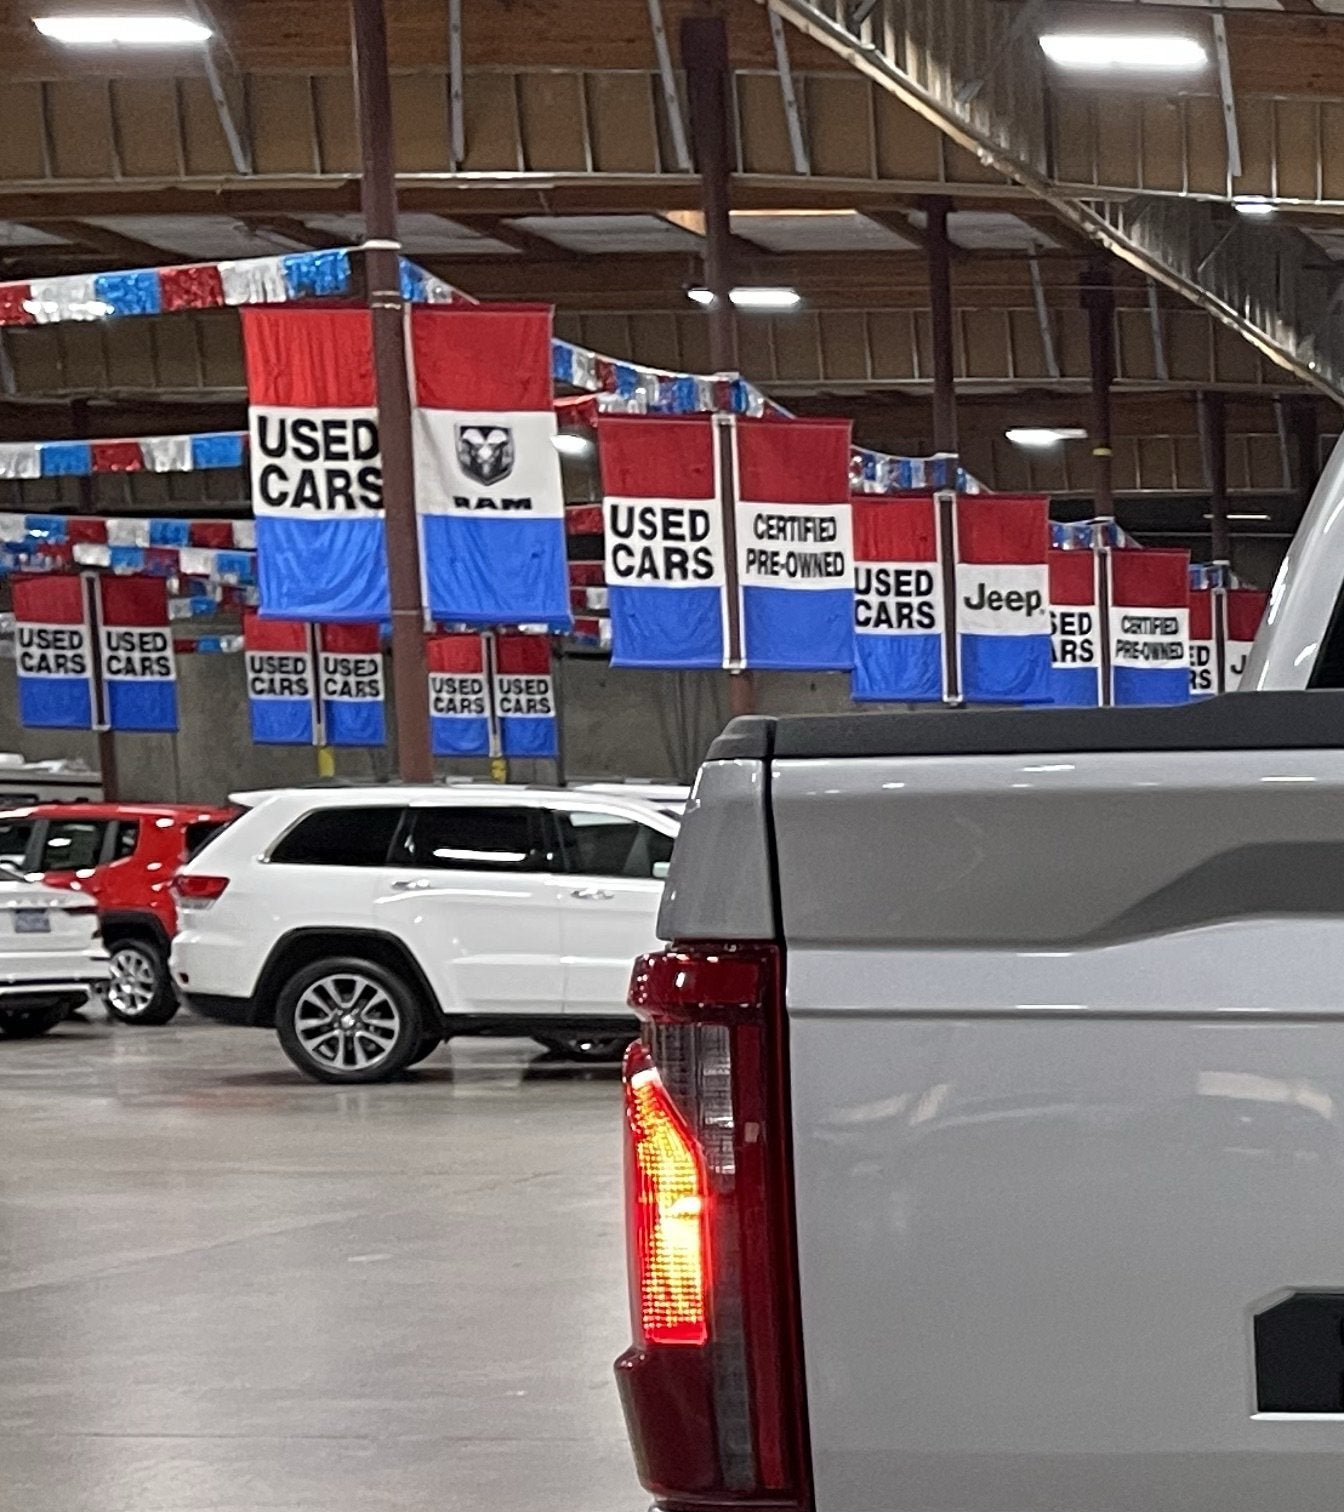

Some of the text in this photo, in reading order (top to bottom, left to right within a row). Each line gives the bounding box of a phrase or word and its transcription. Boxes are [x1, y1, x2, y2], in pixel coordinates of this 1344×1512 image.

[257, 415, 380, 462] USED
[259, 464, 385, 510] CARS
[452, 496, 532, 510] RAM
[610, 504, 711, 542] USED
[753, 513, 837, 542] CERTIFIED
[611, 543, 715, 580] CARS
[746, 548, 845, 578] PRE-OWNED
[854, 567, 934, 597] USED
[963, 582, 1042, 617] Jeep
[854, 598, 936, 630] CARS
[1121, 615, 1179, 635] CERTIFIED
[19, 627, 83, 651] USED
[106, 630, 168, 653] USED
[1115, 640, 1184, 660] PRE-OWNED
[20, 651, 87, 674] CARS
[1050, 639, 1094, 663] RS
[107, 655, 171, 677] CARS
[250, 655, 307, 675] USED
[323, 656, 379, 678] USED
[251, 676, 309, 697] CARS
[324, 677, 381, 698] CARS
[431, 677, 483, 696] USED
[499, 678, 549, 696] USED
[433, 697, 485, 714] CARS
[500, 697, 551, 714] CARS
